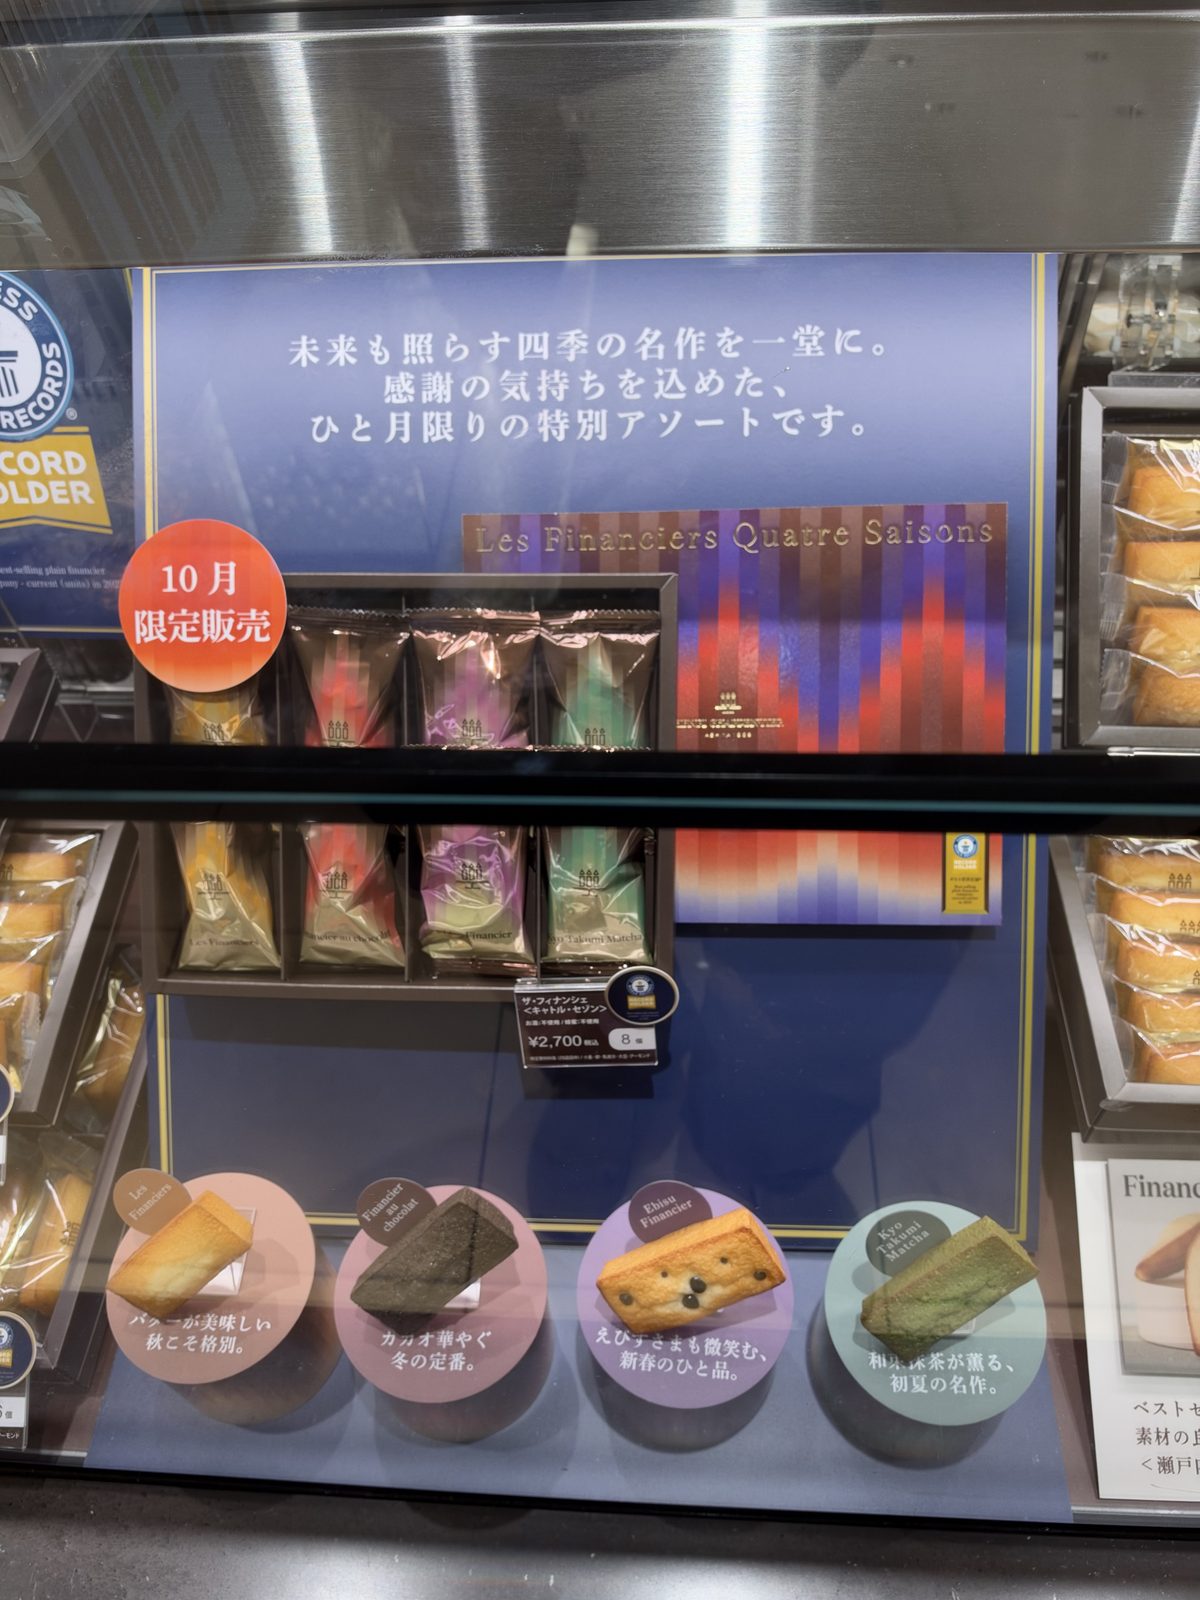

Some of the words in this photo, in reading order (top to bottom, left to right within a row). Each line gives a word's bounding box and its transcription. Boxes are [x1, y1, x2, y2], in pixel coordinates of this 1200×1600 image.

[289, 324, 885, 367] 未来も照らす四季の名作を一堂に。
[384, 366, 786, 404] 感謝の気持ちを込めた、
[311, 404, 864, 443] ひと月限りの特別アソートです。
[476, 527, 529, 552] Les
[544, 526, 718, 552] Financiers
[732, 522, 850, 554] Quatre
[864, 519, 993, 545] Saisons
[134, 608, 272, 645] 限定販売
[128, 1184, 148, 1200] Les
[128, 1183, 173, 1221] Financiers
[361, 1183, 404, 1222] Financier
[643, 1194, 677, 1214] Ebisu
[383, 1198, 419, 1233] chocolat
[386, 1204, 399, 1216] au
[640, 1199, 694, 1228] Financier
[876, 1220, 922, 1255] Takumi
[877, 1221, 904, 1241] Kyo
[884, 1229, 931, 1262] Matcha
[146, 1333, 244, 1354] 秋こそ格別。
[391, 1351, 475, 1371] 冬の定番。
[619, 1350, 738, 1381] 新春のひと品。
[889, 1373, 998, 1395] 初夏の名作。
